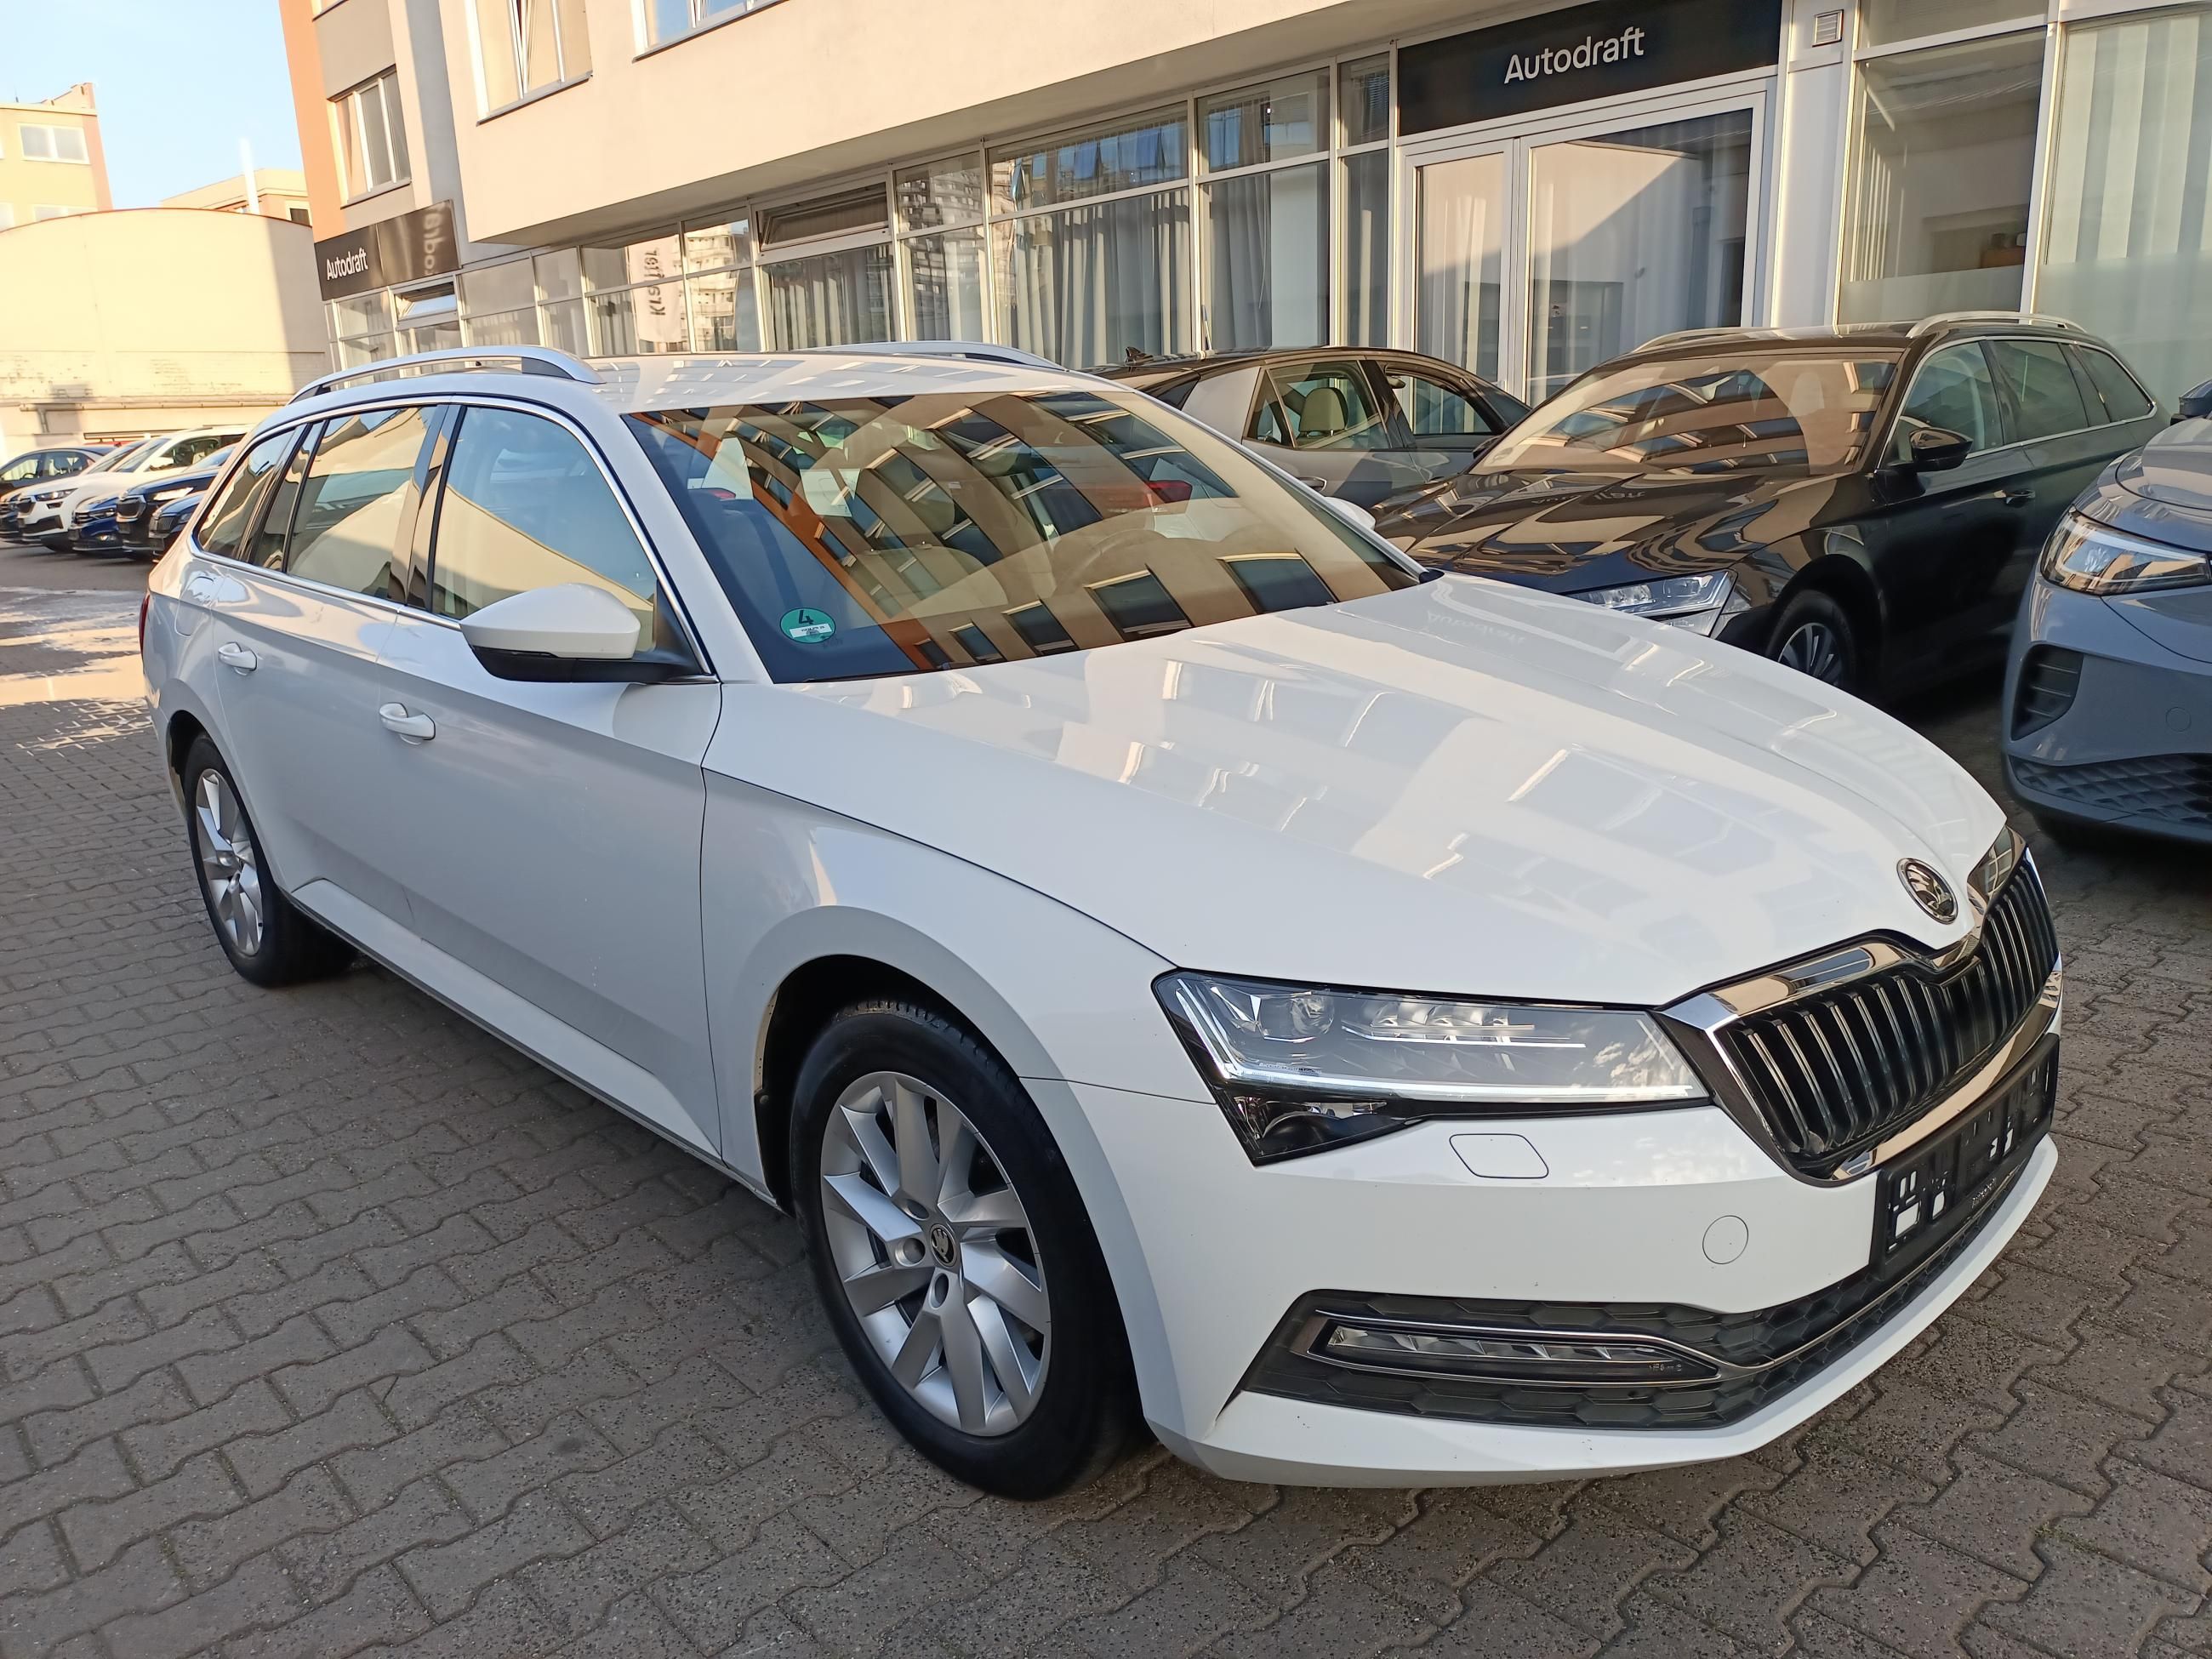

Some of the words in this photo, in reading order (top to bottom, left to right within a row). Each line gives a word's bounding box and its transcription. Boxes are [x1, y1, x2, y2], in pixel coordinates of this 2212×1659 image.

[1504, 26, 1645, 84] Autodraft
[326, 247, 368, 281] Autodraft
[798, 609, 814, 625] 4
